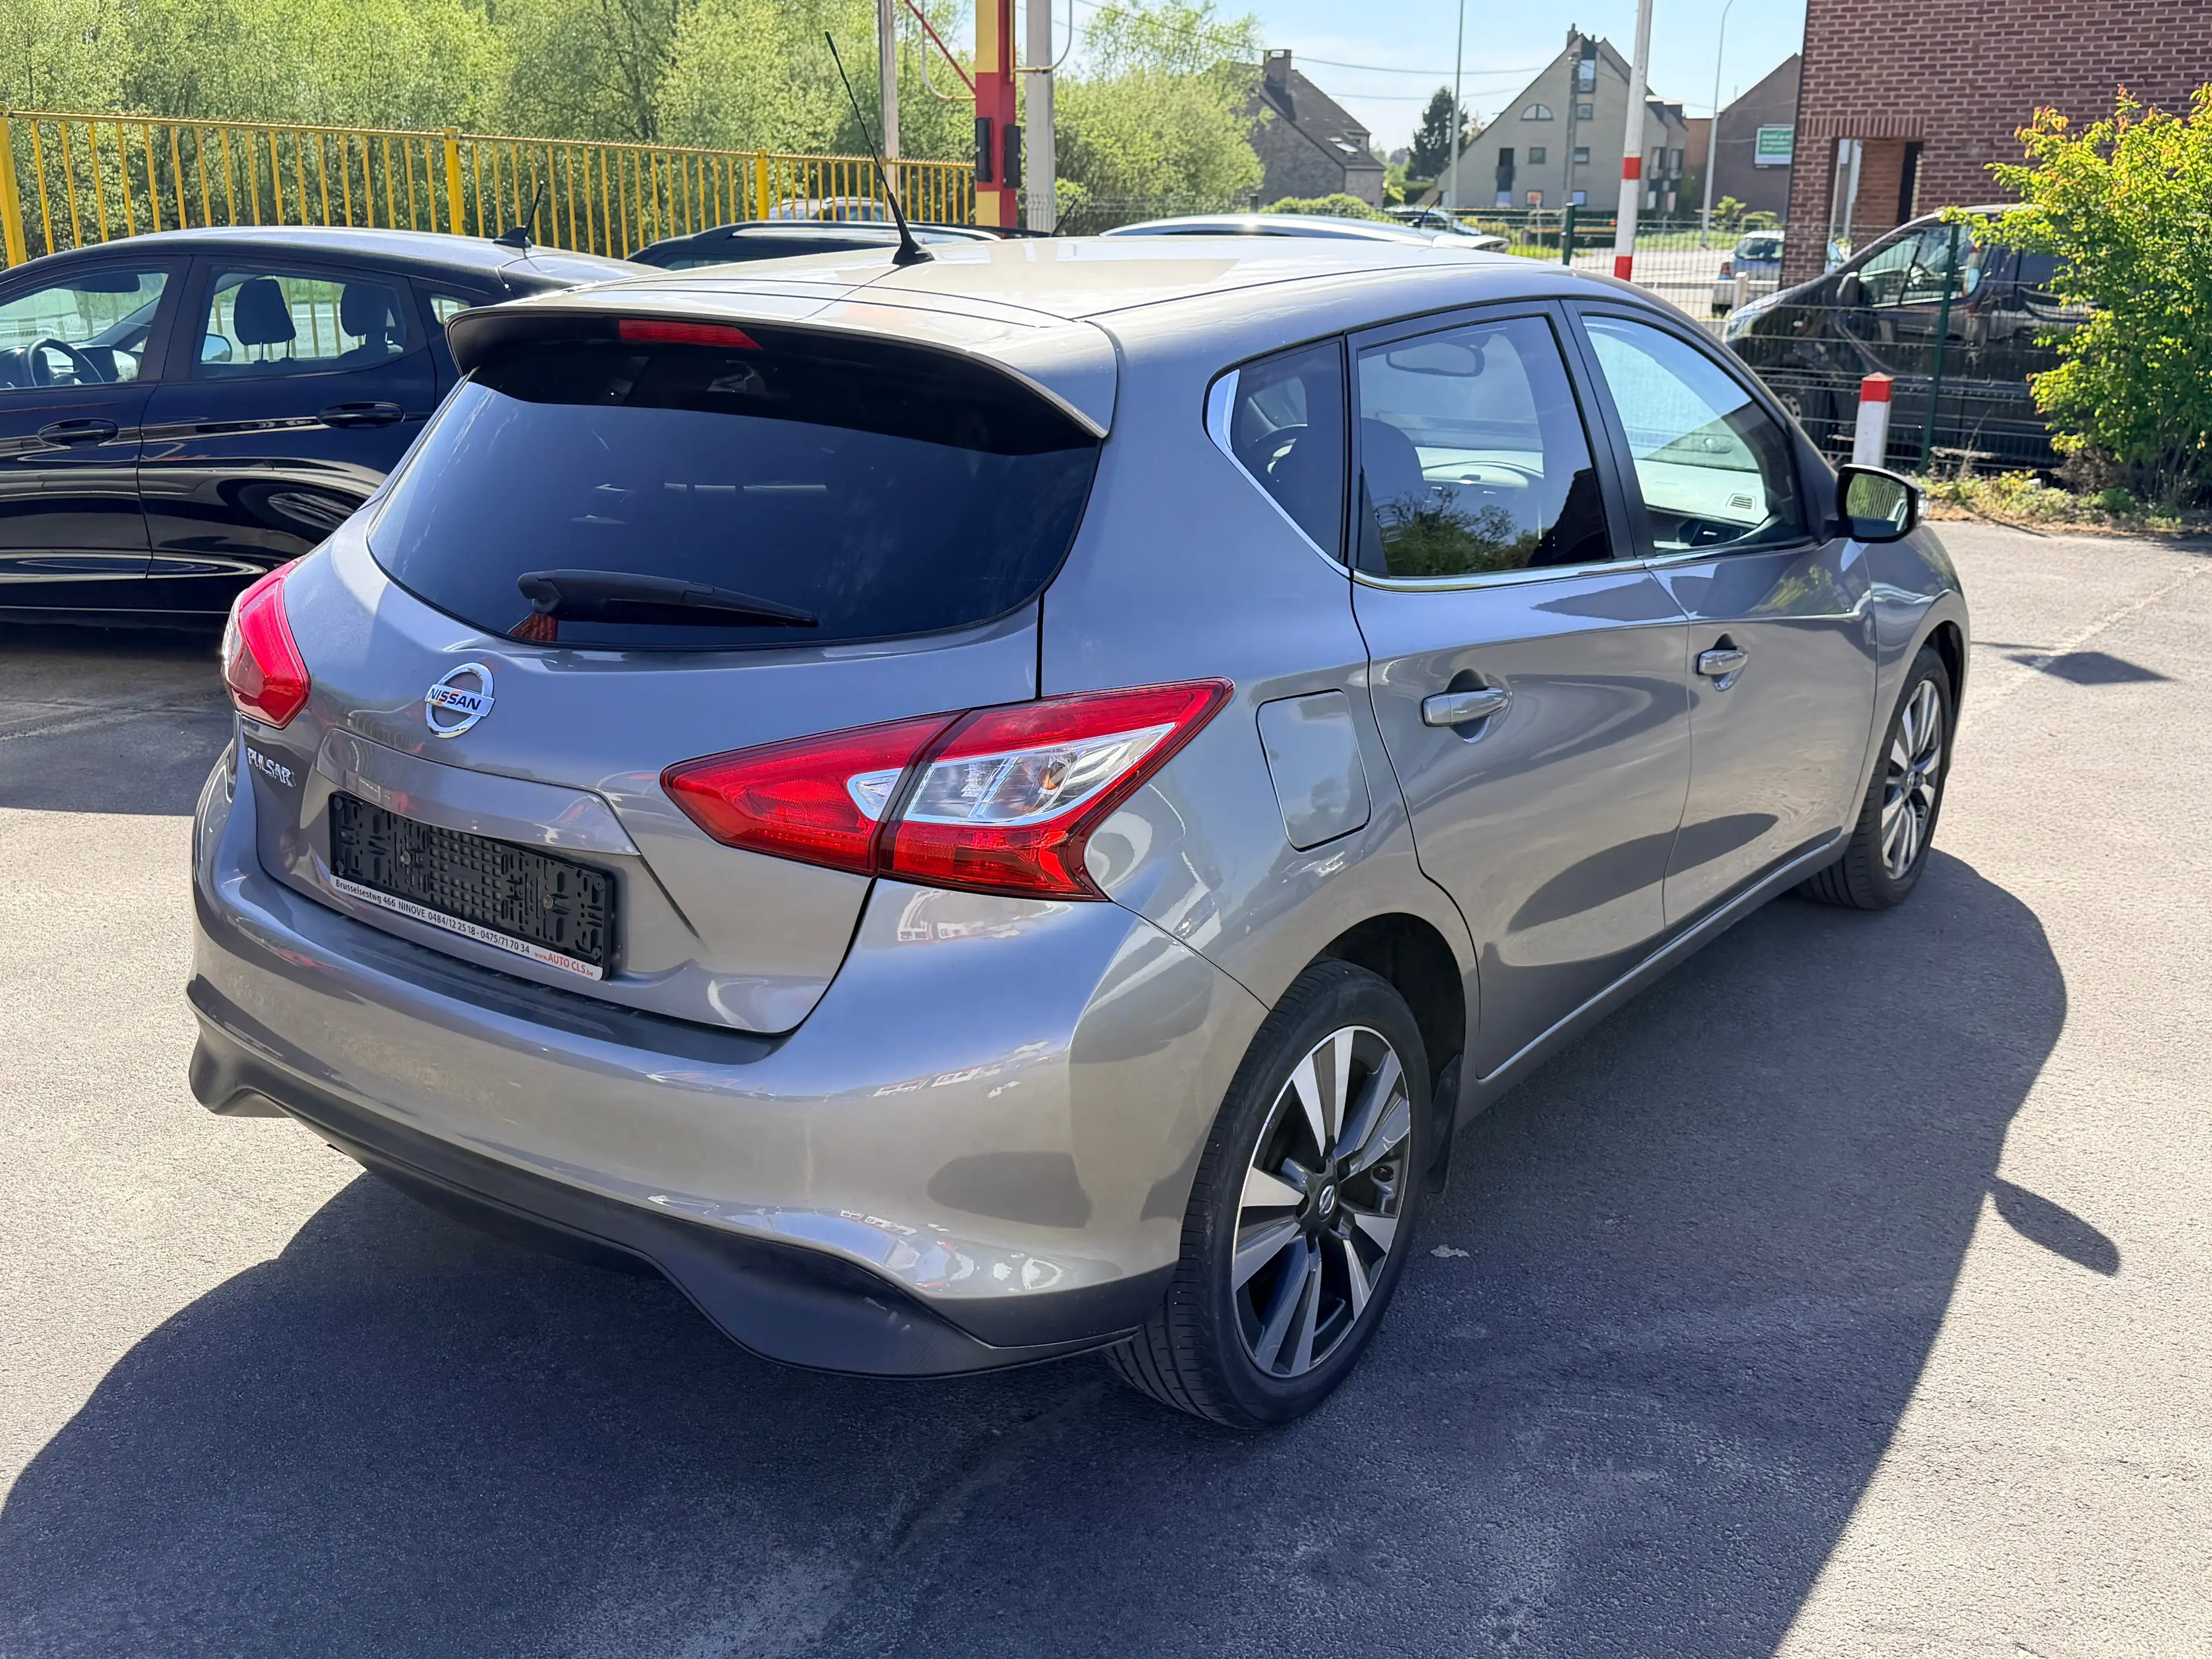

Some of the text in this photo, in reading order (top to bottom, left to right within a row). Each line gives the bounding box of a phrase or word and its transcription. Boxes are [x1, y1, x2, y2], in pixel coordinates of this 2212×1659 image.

[428, 688, 482, 710] NISSAN
[248, 747, 294, 787] PULSAR
[336, 879, 381, 904] Brusselsestwg
[383, 896, 396, 907] 466
[399, 901, 425, 918] NINOVE
[428, 911, 456, 929] 0484/12
[457, 923, 466, 932] 25
[467, 925, 475, 935] 18
[480, 930, 508, 947] 0475/71
[510, 940, 518, 950] 70
[520, 943, 529, 955] 34
